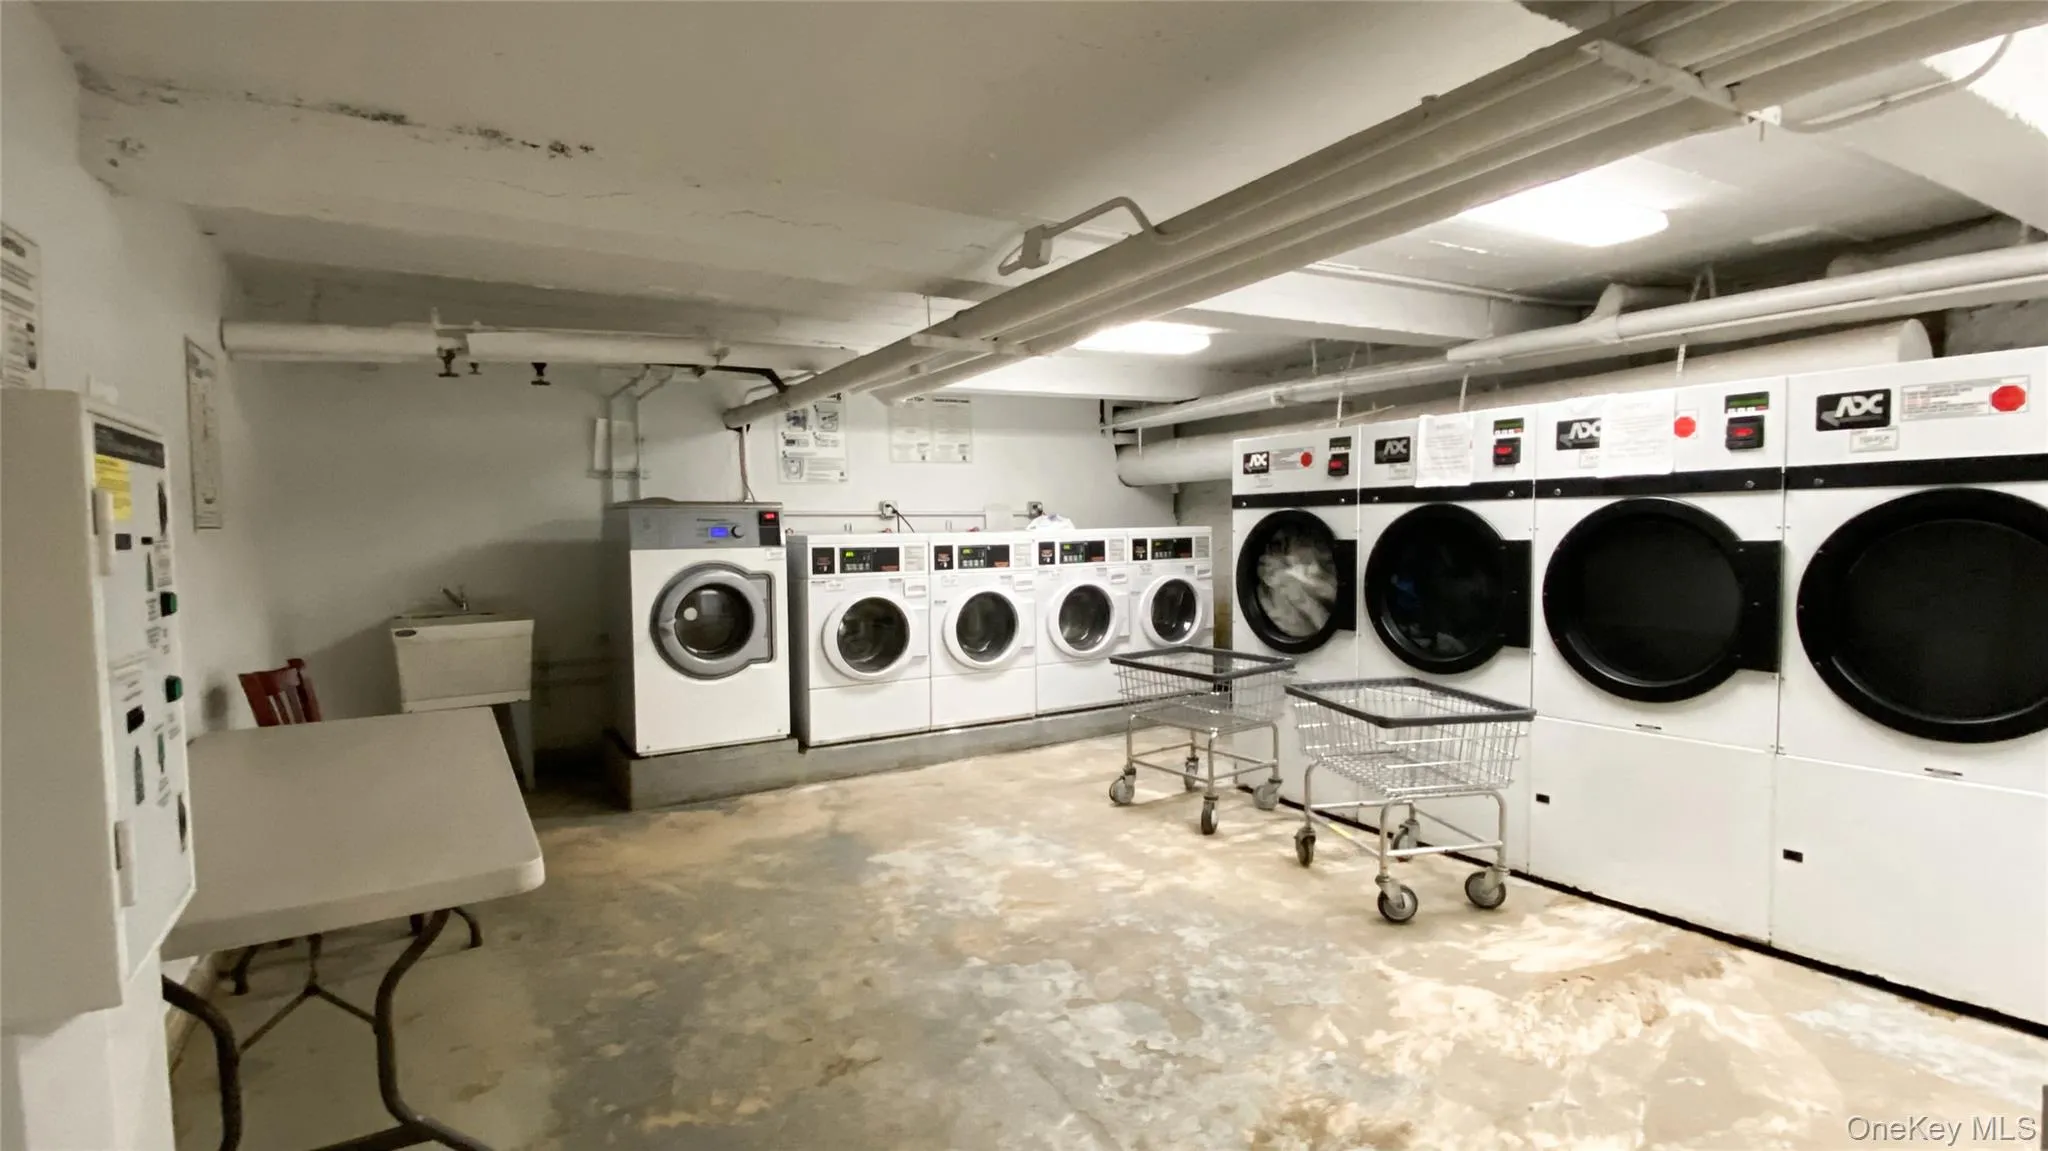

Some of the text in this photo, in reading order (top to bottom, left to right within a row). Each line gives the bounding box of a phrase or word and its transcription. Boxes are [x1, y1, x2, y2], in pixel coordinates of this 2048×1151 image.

[1835, 394, 1884, 417] ADC
[1383, 439, 1408, 455] ADC
[1249, 453, 1268, 466] ADC
